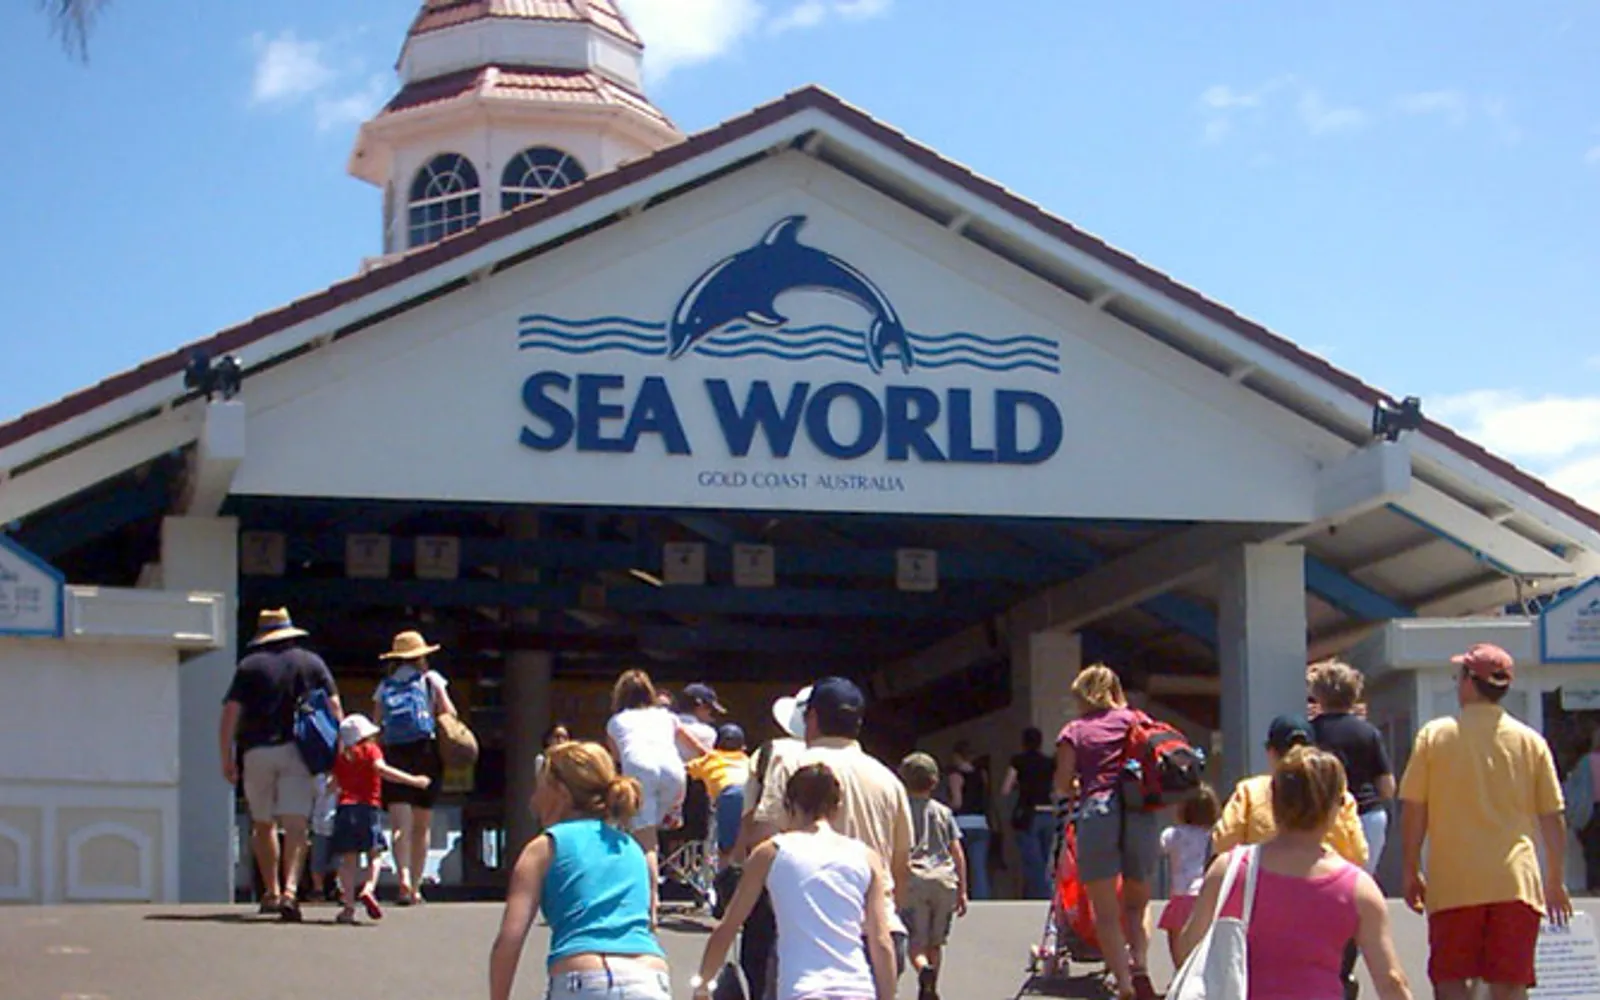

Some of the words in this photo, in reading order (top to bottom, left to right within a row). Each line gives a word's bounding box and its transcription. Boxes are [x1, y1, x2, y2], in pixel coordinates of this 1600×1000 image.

[519, 370, 692, 455] SEA
[703, 378, 1064, 466] WORLD
[698, 471, 747, 487] GOLD
[752, 472, 807, 489] COAST
[816, 473, 905, 492] AUSTRALIA
